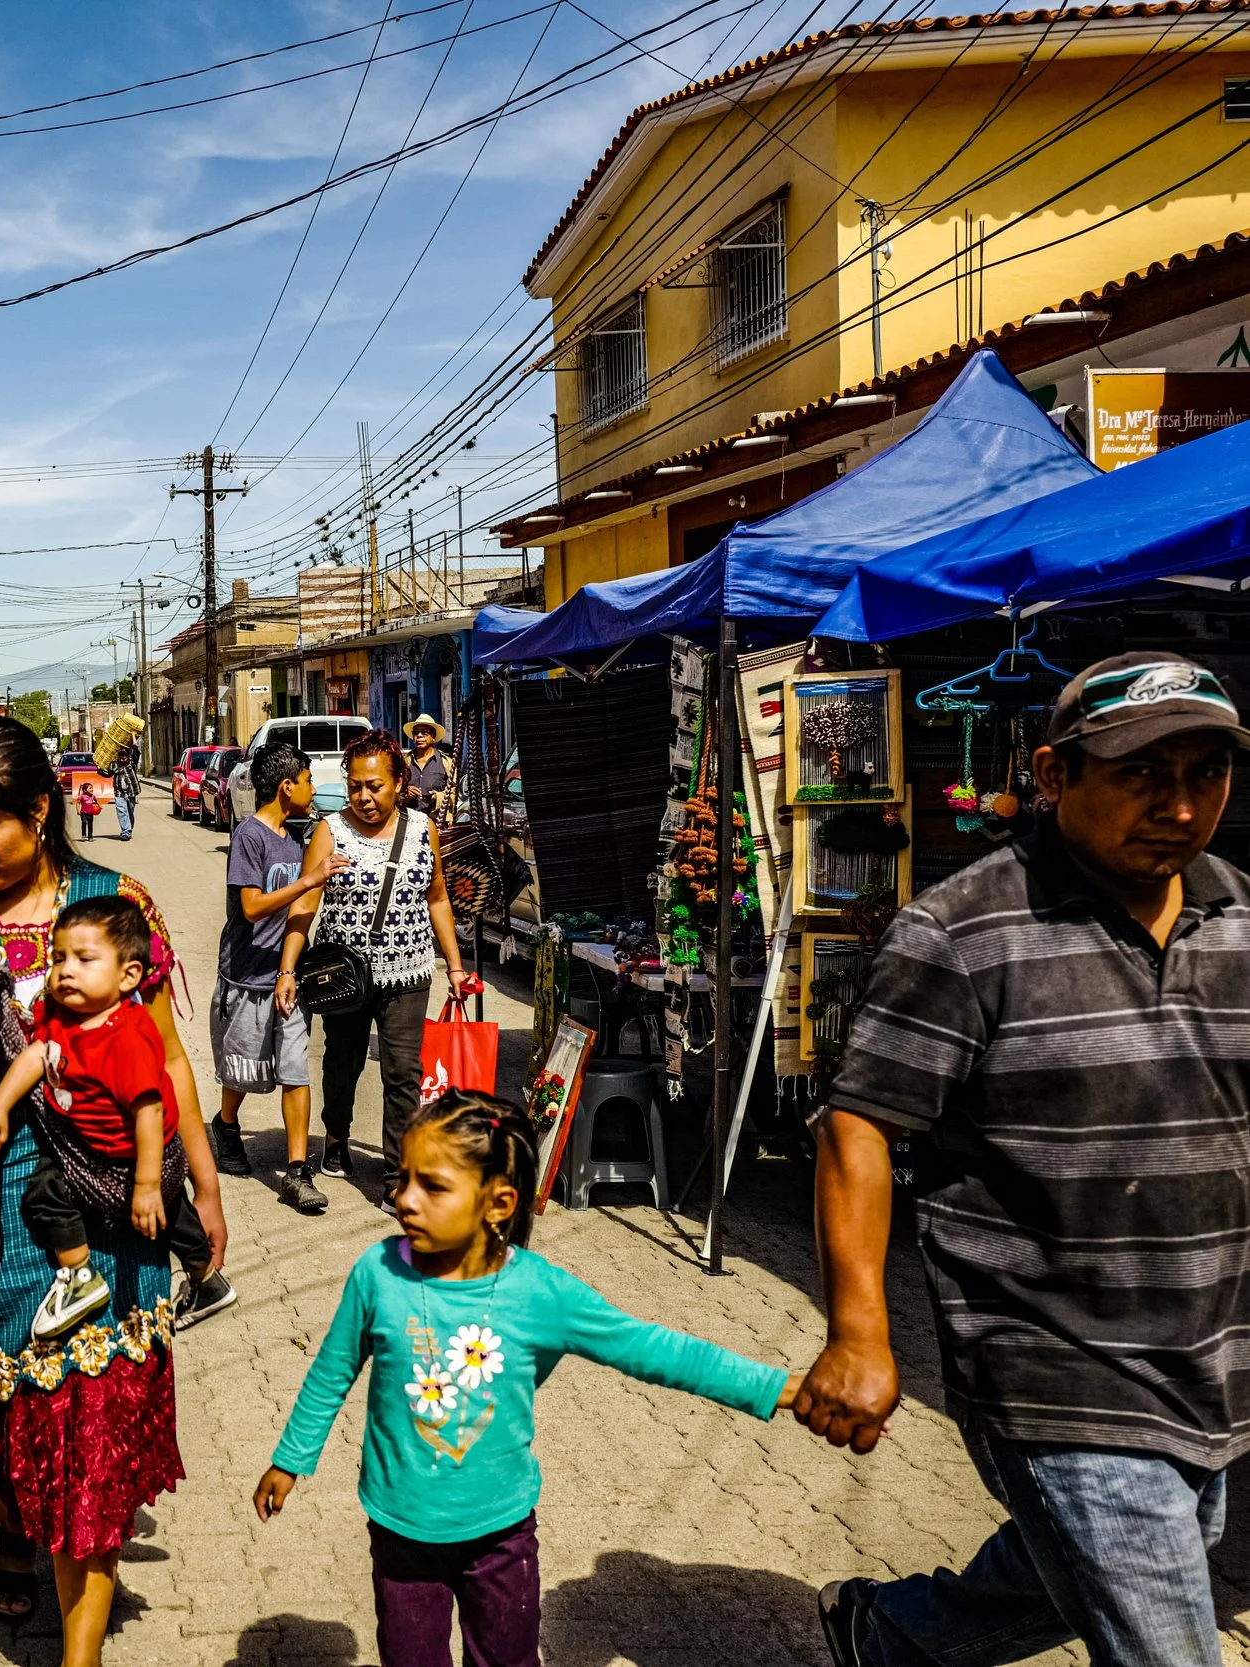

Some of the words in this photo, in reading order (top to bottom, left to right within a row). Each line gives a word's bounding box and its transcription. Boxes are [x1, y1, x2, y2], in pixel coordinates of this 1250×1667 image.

[1098, 408, 1121, 430] Dra
[1142, 410, 1181, 434] Teresa
[1178, 407, 1248, 432] Hernánde
